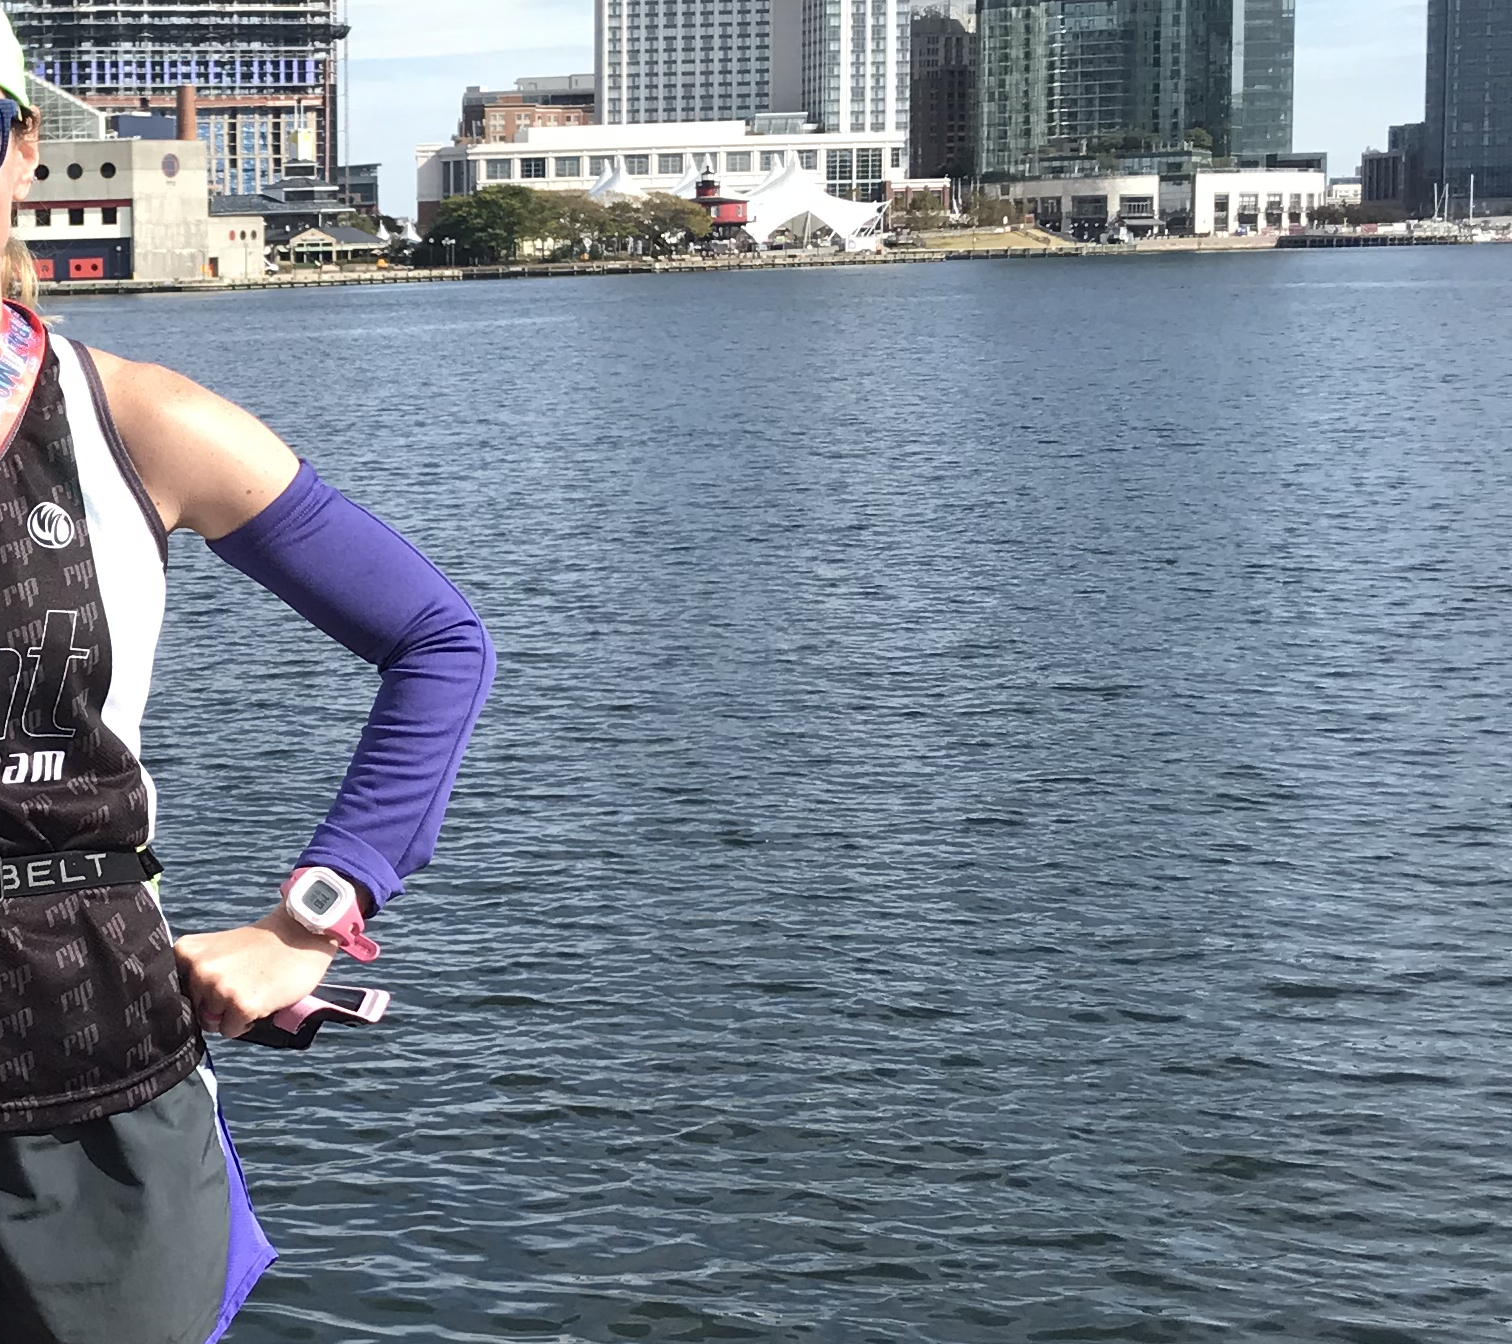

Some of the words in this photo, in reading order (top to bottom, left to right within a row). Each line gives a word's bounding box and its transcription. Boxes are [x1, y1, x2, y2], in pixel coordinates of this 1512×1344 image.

[0, 537, 33, 566] rip
[63, 559, 94, 590] rip
[3, 577, 39, 607] rip
[45, 893, 80, 928] rip
[55, 936, 88, 969] rip
[60, 979, 95, 1013] rip
[63, 1023, 100, 1056] rip
[0, 1050, 35, 1082] rip
